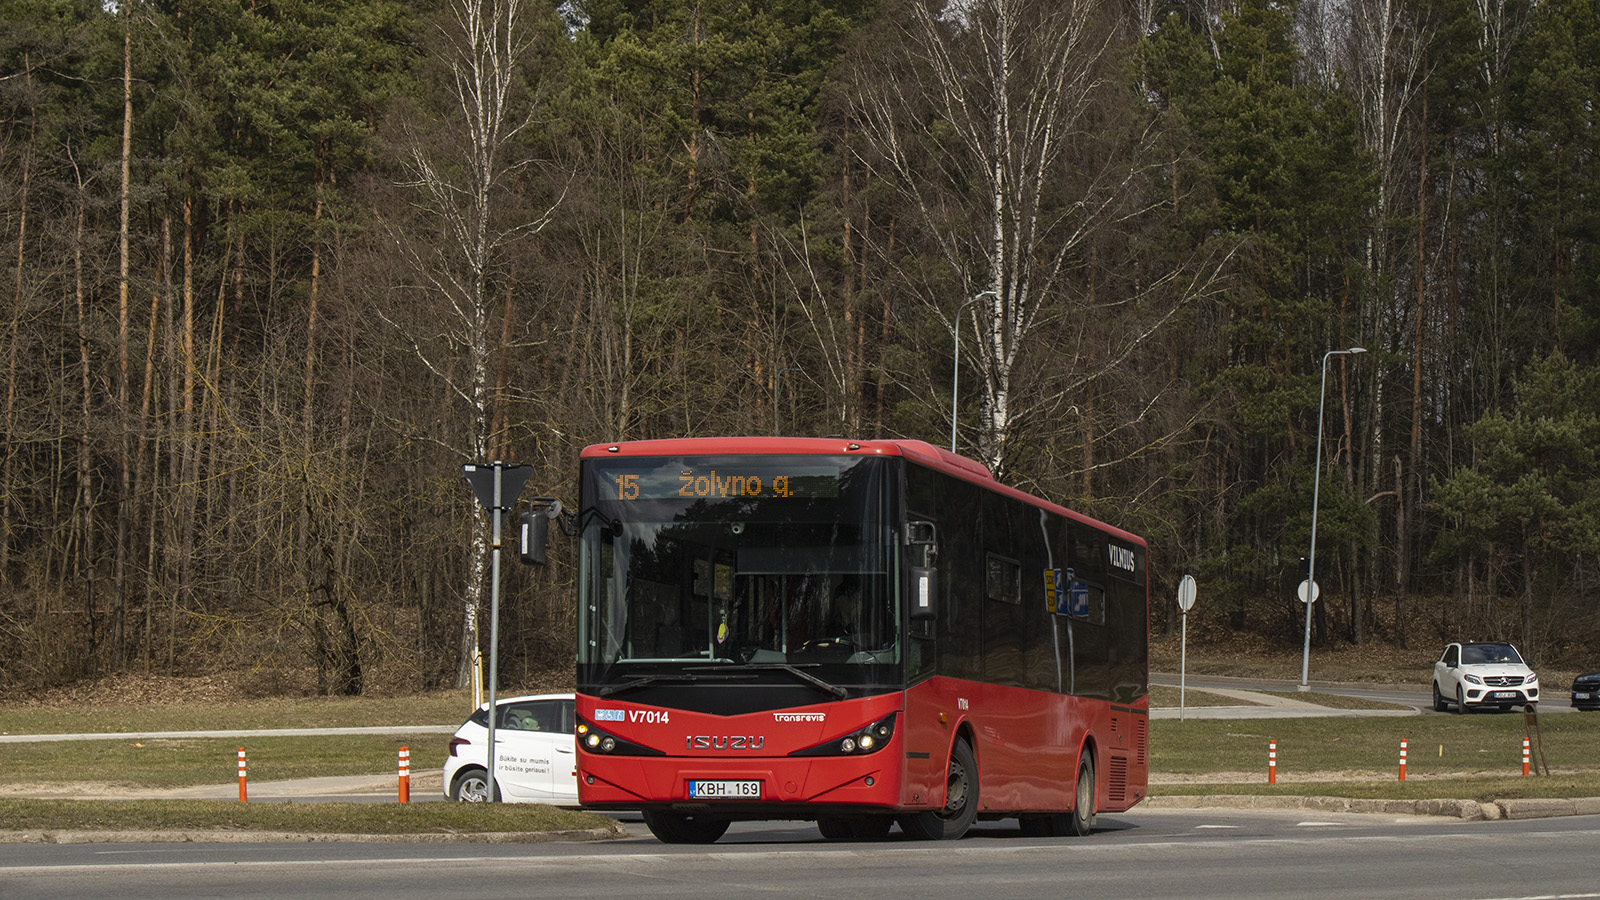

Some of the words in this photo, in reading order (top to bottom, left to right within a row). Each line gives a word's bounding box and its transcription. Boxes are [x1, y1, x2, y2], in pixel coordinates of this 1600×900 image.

[616, 475, 640, 500] 15
[1108, 543, 1135, 573] VILNIUS
[628, 710, 670, 724] V7014
[686, 735, 764, 750] ISUZU
[697, 782, 726, 795] KBH
[735, 782, 758, 795] 169
